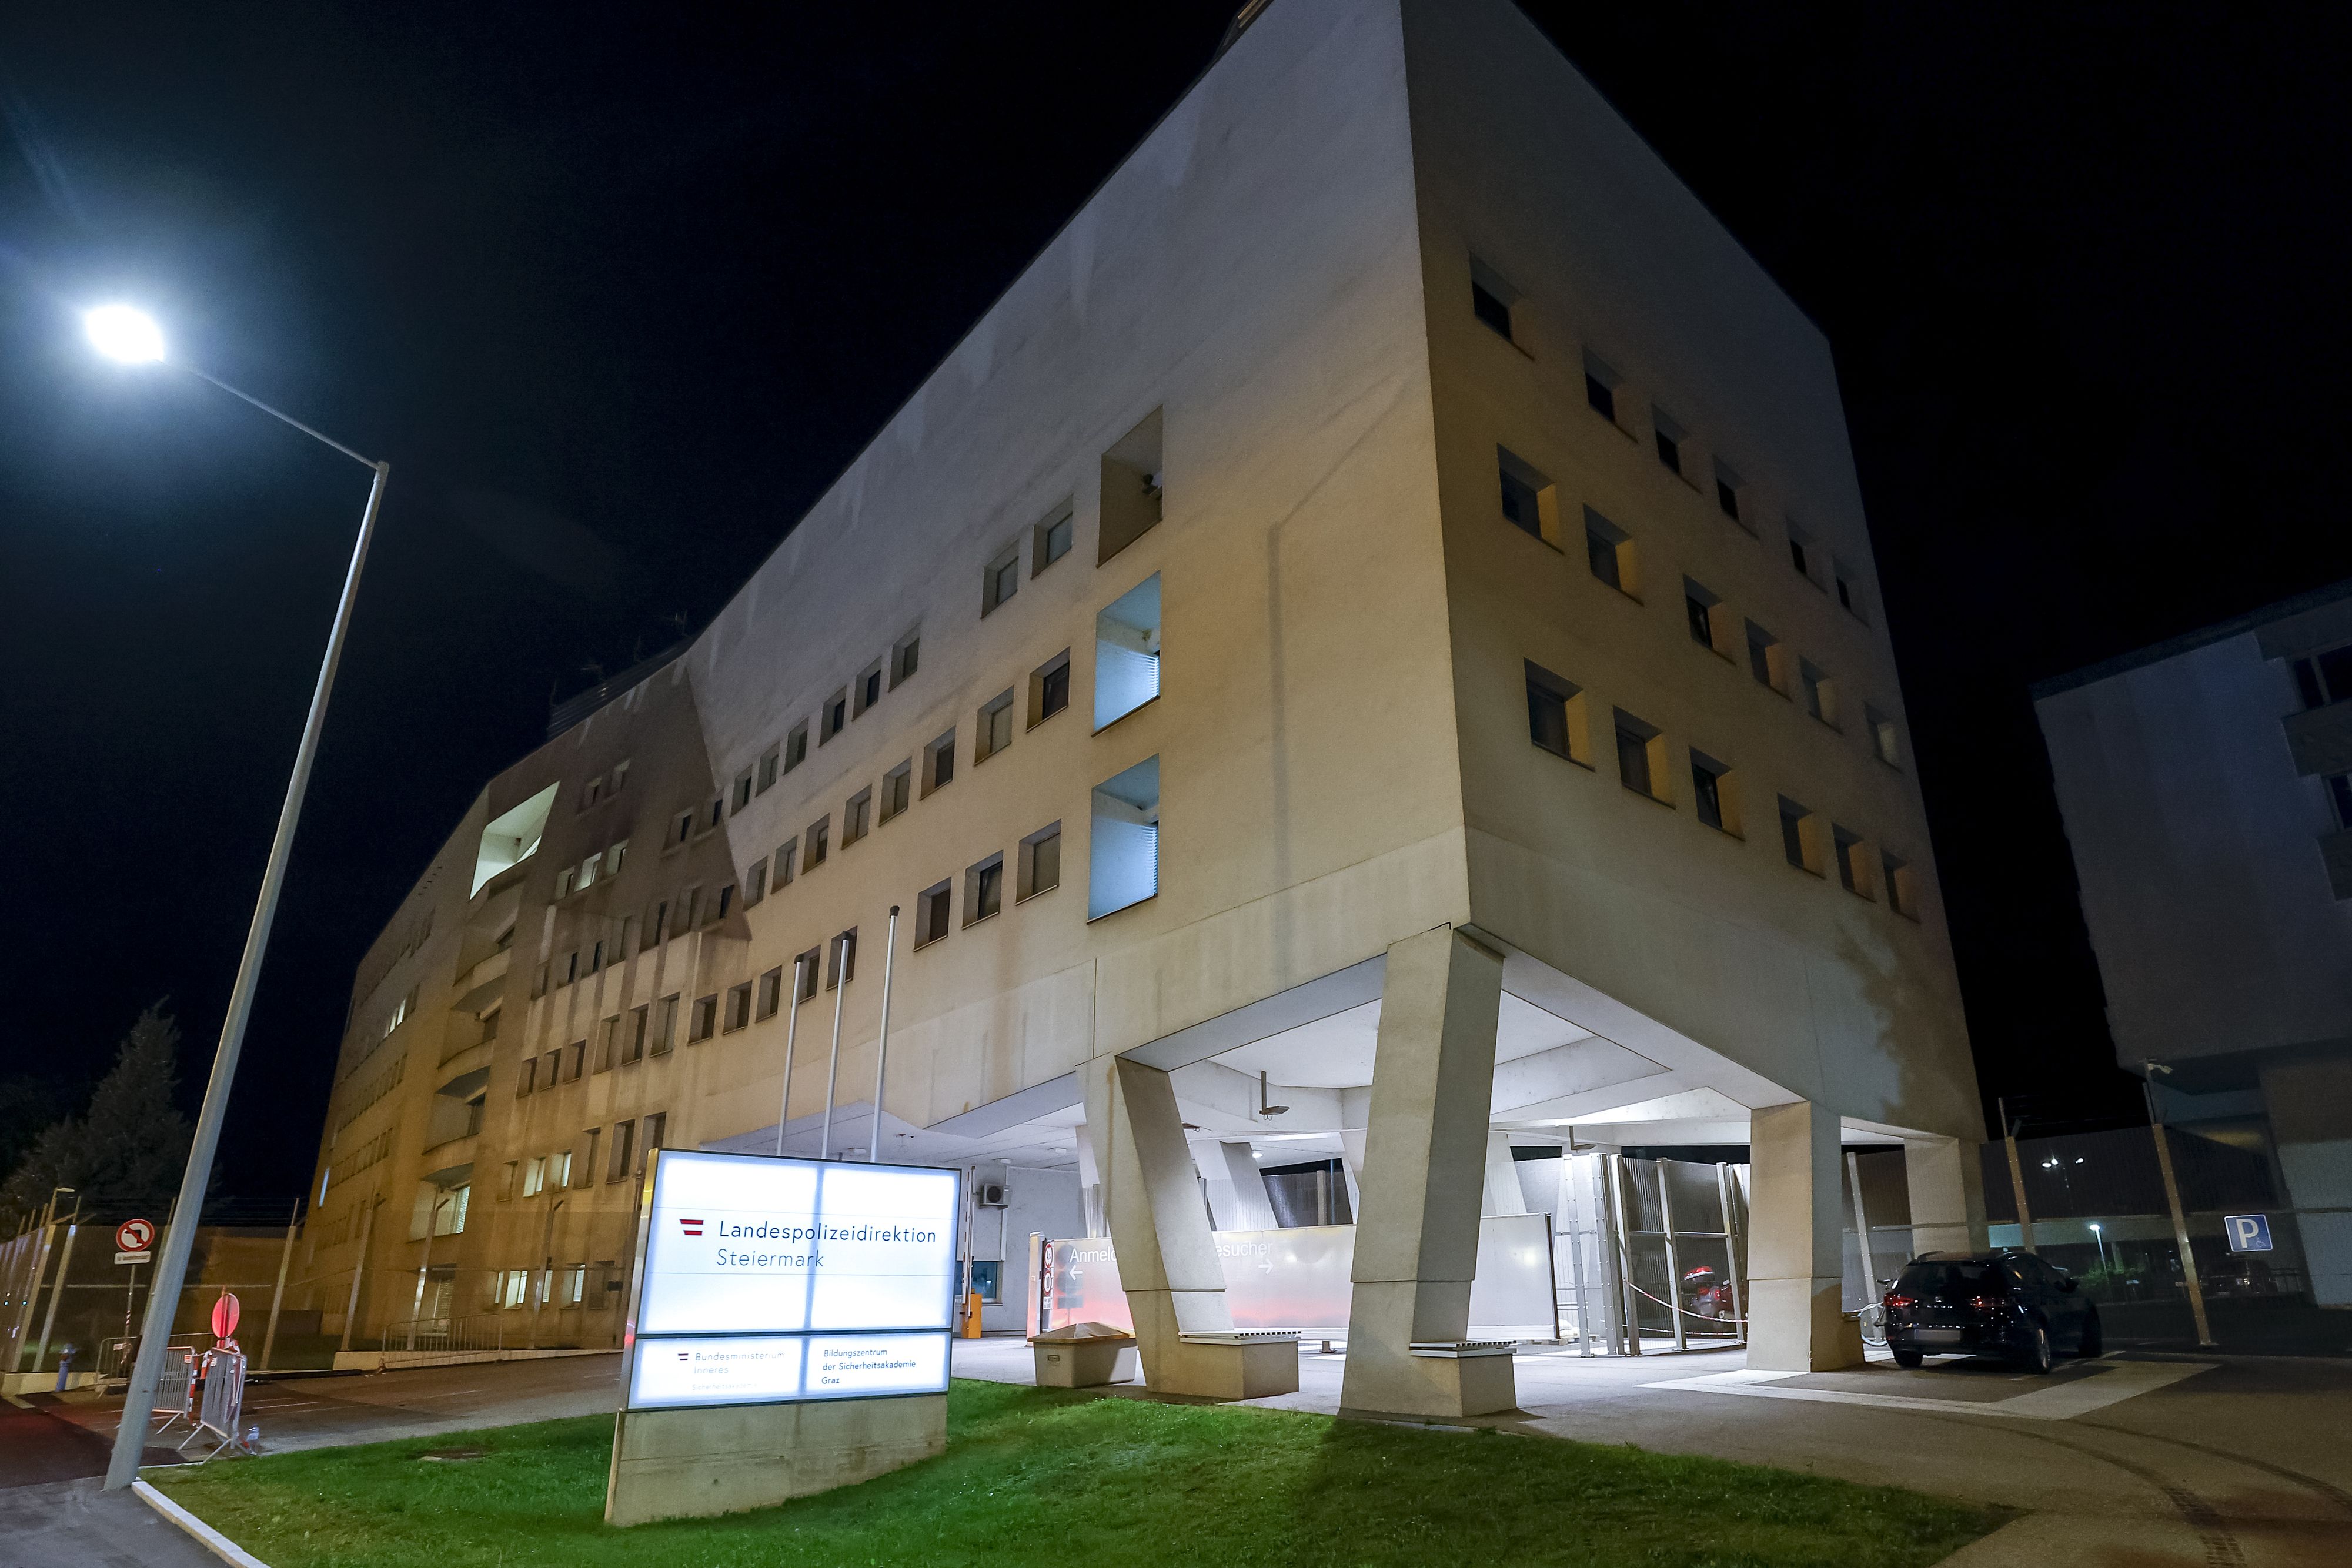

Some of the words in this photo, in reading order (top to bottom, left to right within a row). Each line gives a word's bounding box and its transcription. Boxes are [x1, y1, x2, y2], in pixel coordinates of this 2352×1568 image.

[719, 1220, 936, 1244] Landespolizeidirektion
[2236, 1218, 2259, 1248] P
[1215, 1241, 1273, 1258] esucher
[716, 1248, 824, 1267] Steiermark
[696, 1352, 785, 1361] Bundesministerium
[824, 1349, 887, 1359] Bildungszentrum
[838, 1360, 916, 1370] Sicherheitsakademie
[694, 1366, 729, 1375] Inneres
[821, 1376, 840, 1385] Graz
